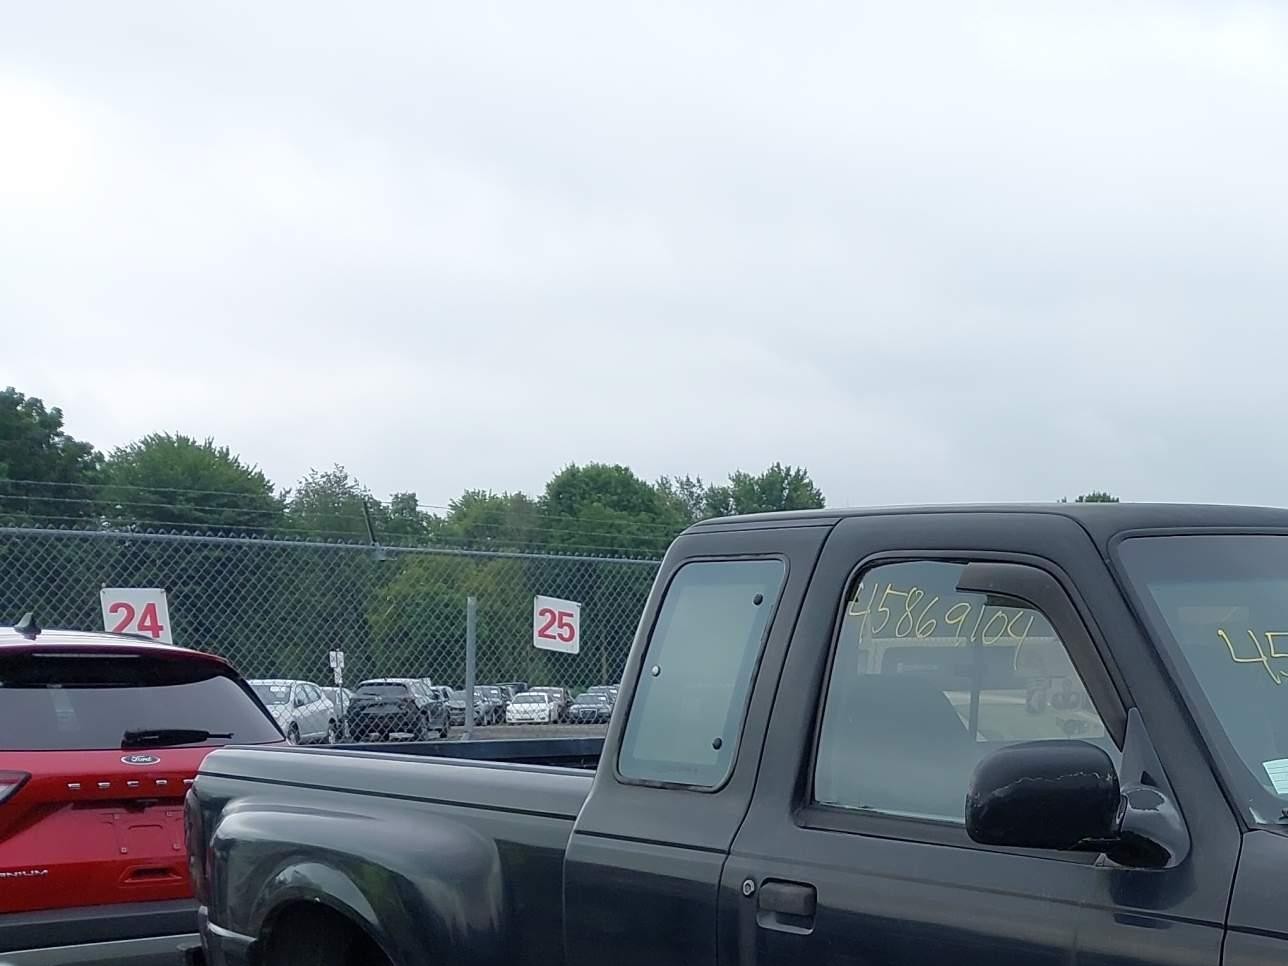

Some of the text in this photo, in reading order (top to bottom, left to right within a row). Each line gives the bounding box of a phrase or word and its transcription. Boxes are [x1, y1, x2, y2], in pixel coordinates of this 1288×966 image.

[108, 602, 164, 639] 24
[537, 607, 576, 643] 25
[849, 582, 1036, 672] 45869104
[67, 778, 196, 790] ESCAP
